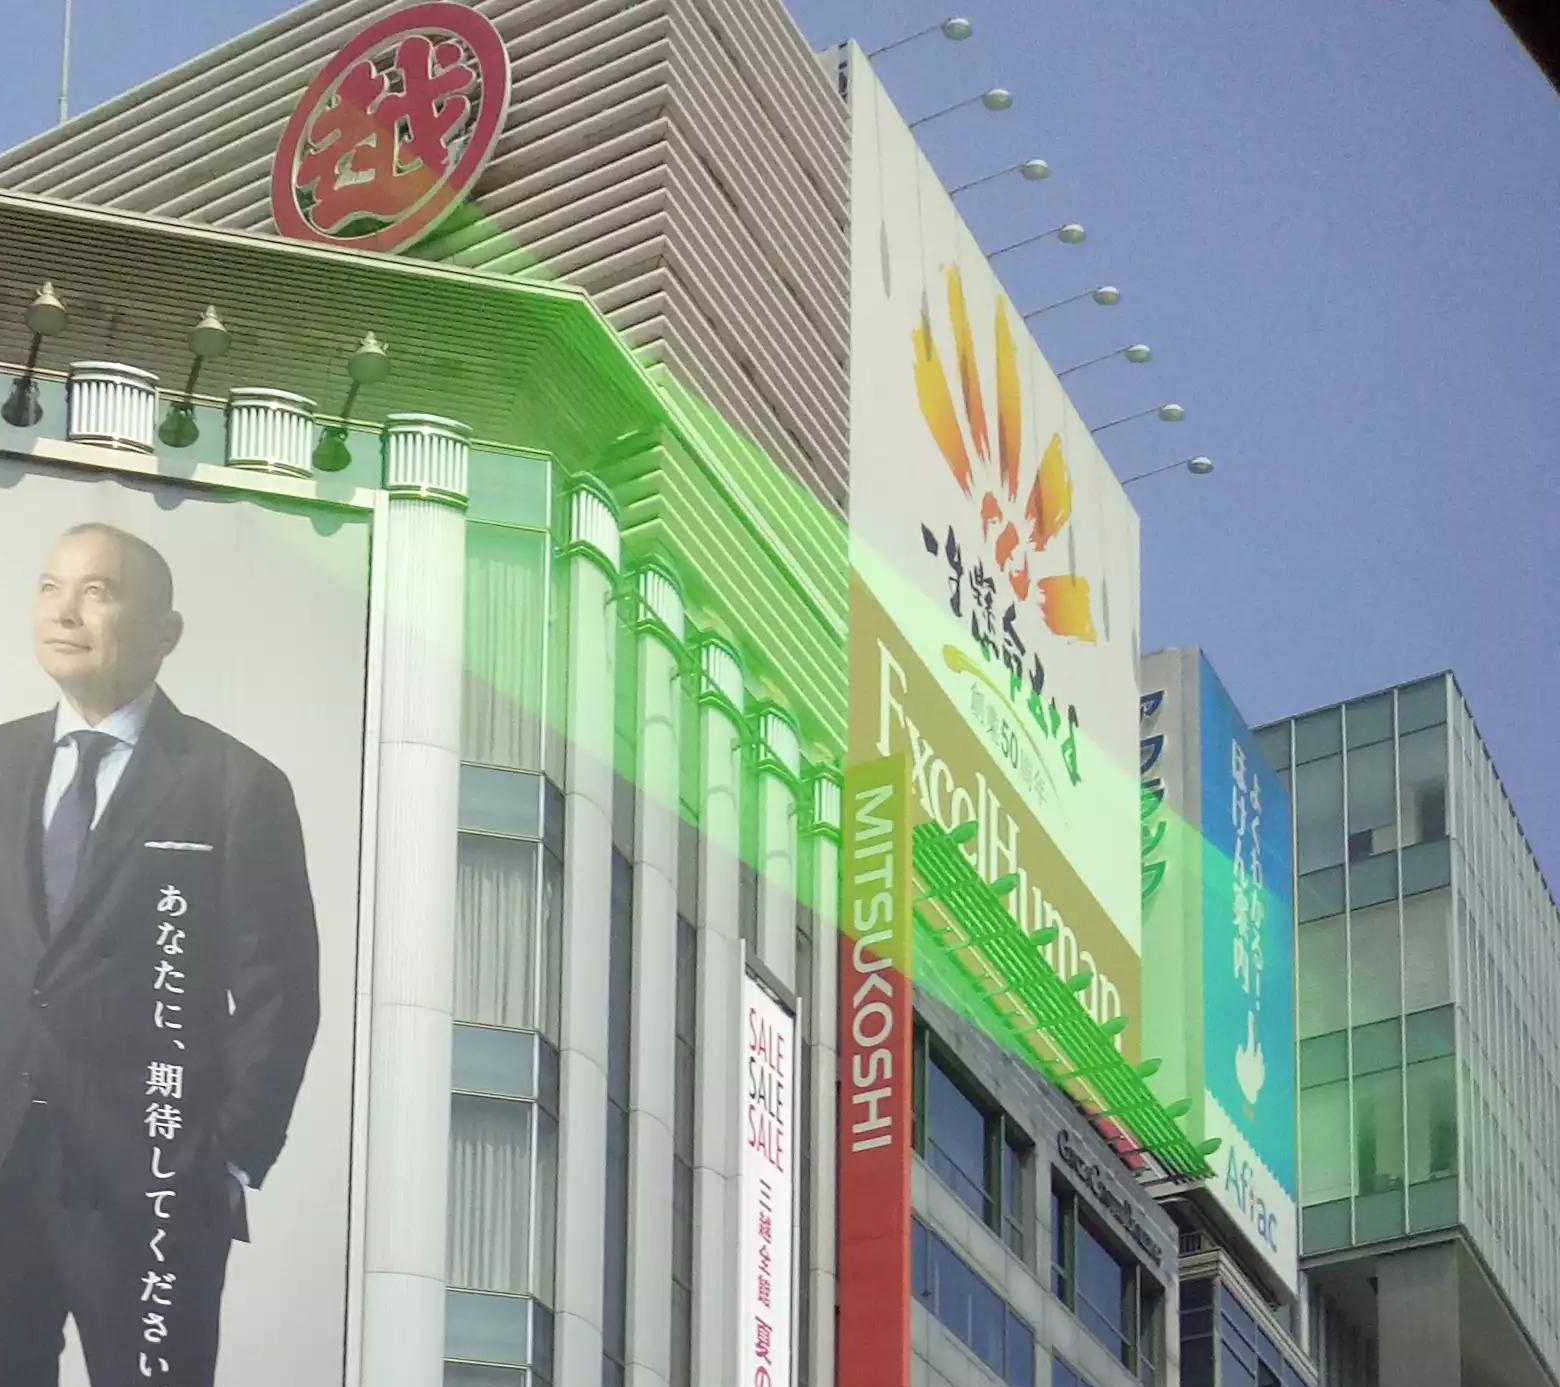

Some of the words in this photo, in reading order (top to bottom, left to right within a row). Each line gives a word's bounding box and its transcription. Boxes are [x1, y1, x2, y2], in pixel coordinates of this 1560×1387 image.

[851, 783, 893, 1153] MITSUKOSHI
[748, 1006, 785, 1079] SALE
[748, 1055, 785, 1126] SALE
[748, 1104, 785, 1174] SALE
[1224, 1142, 1280, 1256] Aflac
